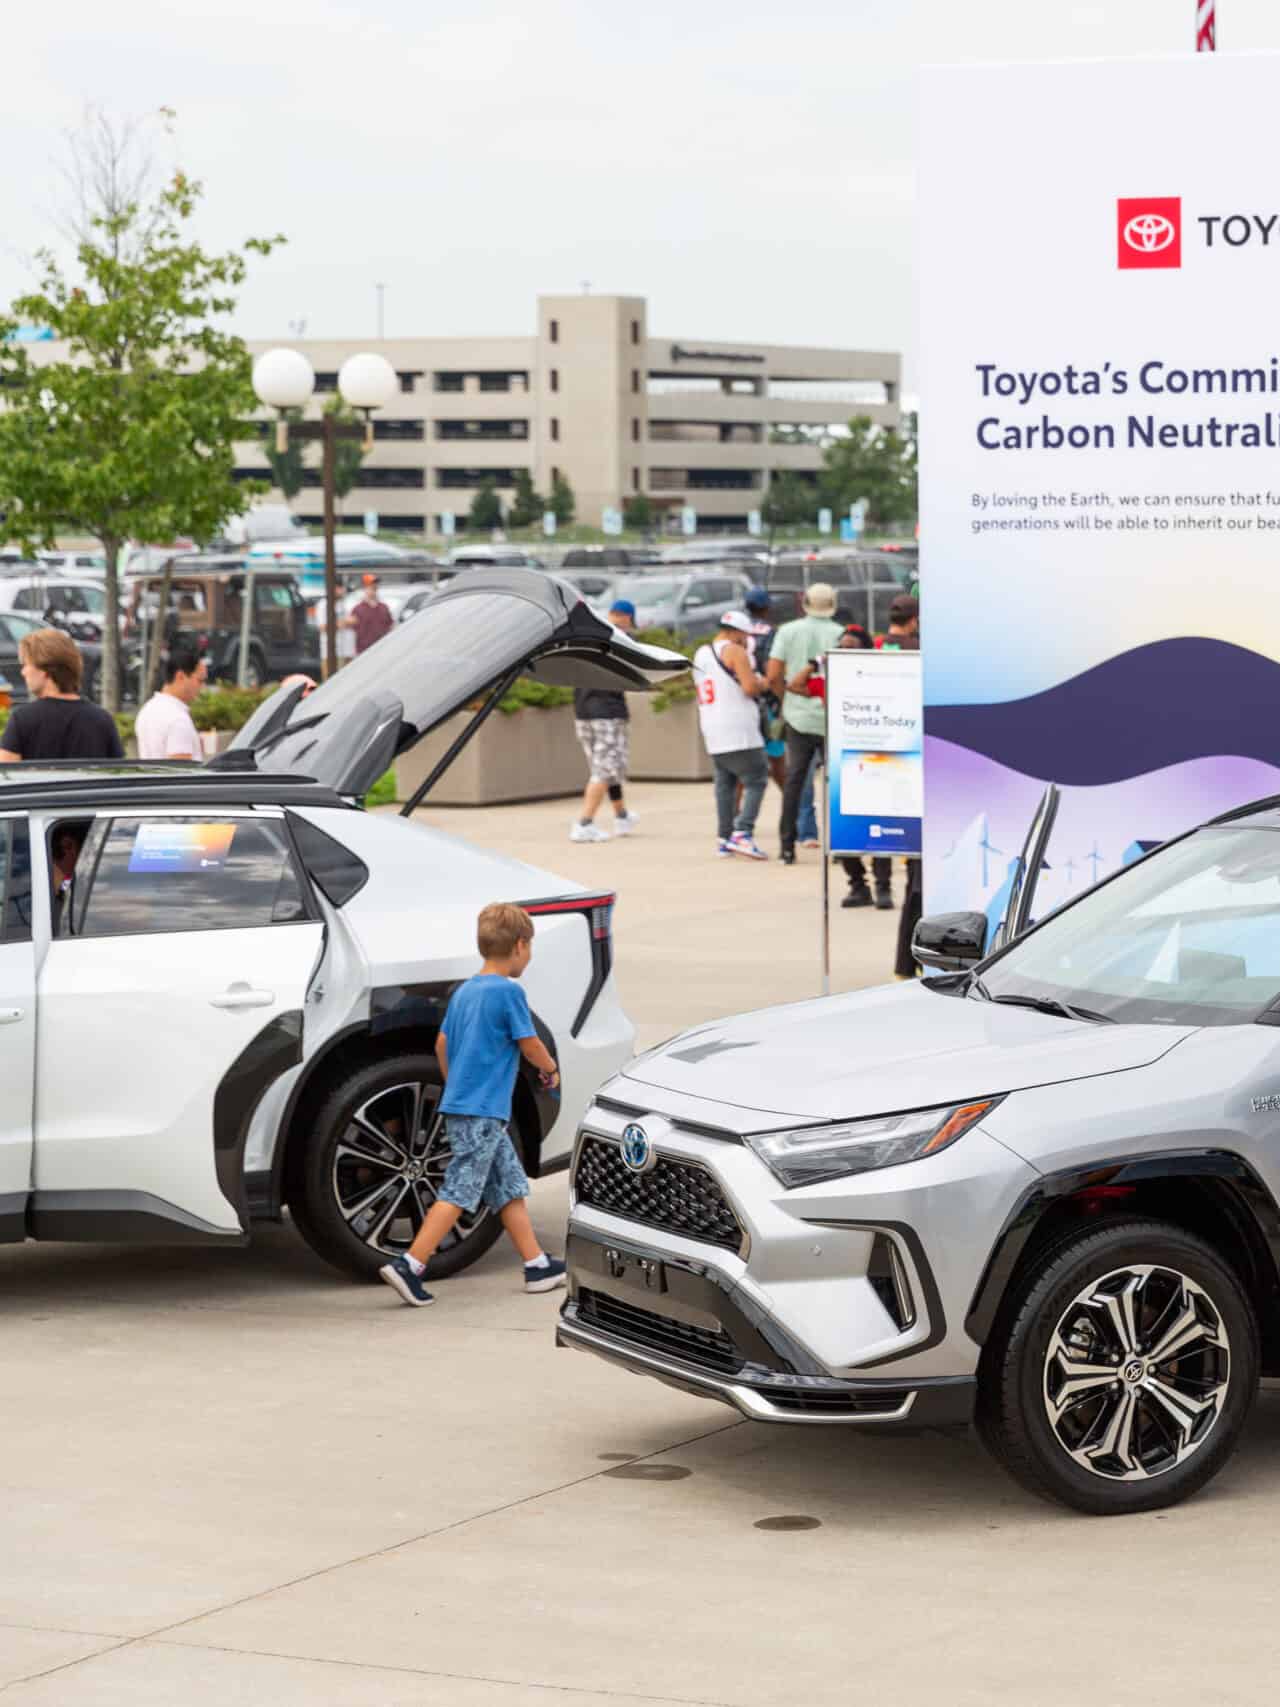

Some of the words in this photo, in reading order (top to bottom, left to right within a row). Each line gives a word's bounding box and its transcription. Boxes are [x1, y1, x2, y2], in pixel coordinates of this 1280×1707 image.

[975, 360, 1129, 406] Toyota's
[976, 414, 1115, 451] Carbon
[971, 493, 989, 509] By
[992, 492, 1038, 510] loving
[1042, 493, 1066, 507] the
[1071, 492, 1115, 509] Earth,
[1119, 495, 1141, 507] we
[1144, 495, 1171, 507] can
[1174, 495, 1226, 507] ensure
[1230, 491, 1262, 507] that
[971, 516, 1060, 534] generations
[1063, 515, 1090, 530] will
[1094, 515, 1113, 530] be
[1117, 515, 1150, 530] able
[1153, 516, 1170, 530] to
[1173, 515, 1223, 530] inherit
[1226, 518, 1253, 530] our
[841, 700, 871, 713] Drive
[874, 704, 881, 713] a
[840, 714, 880, 730] Toyota
[883, 715, 917, 729] Today
